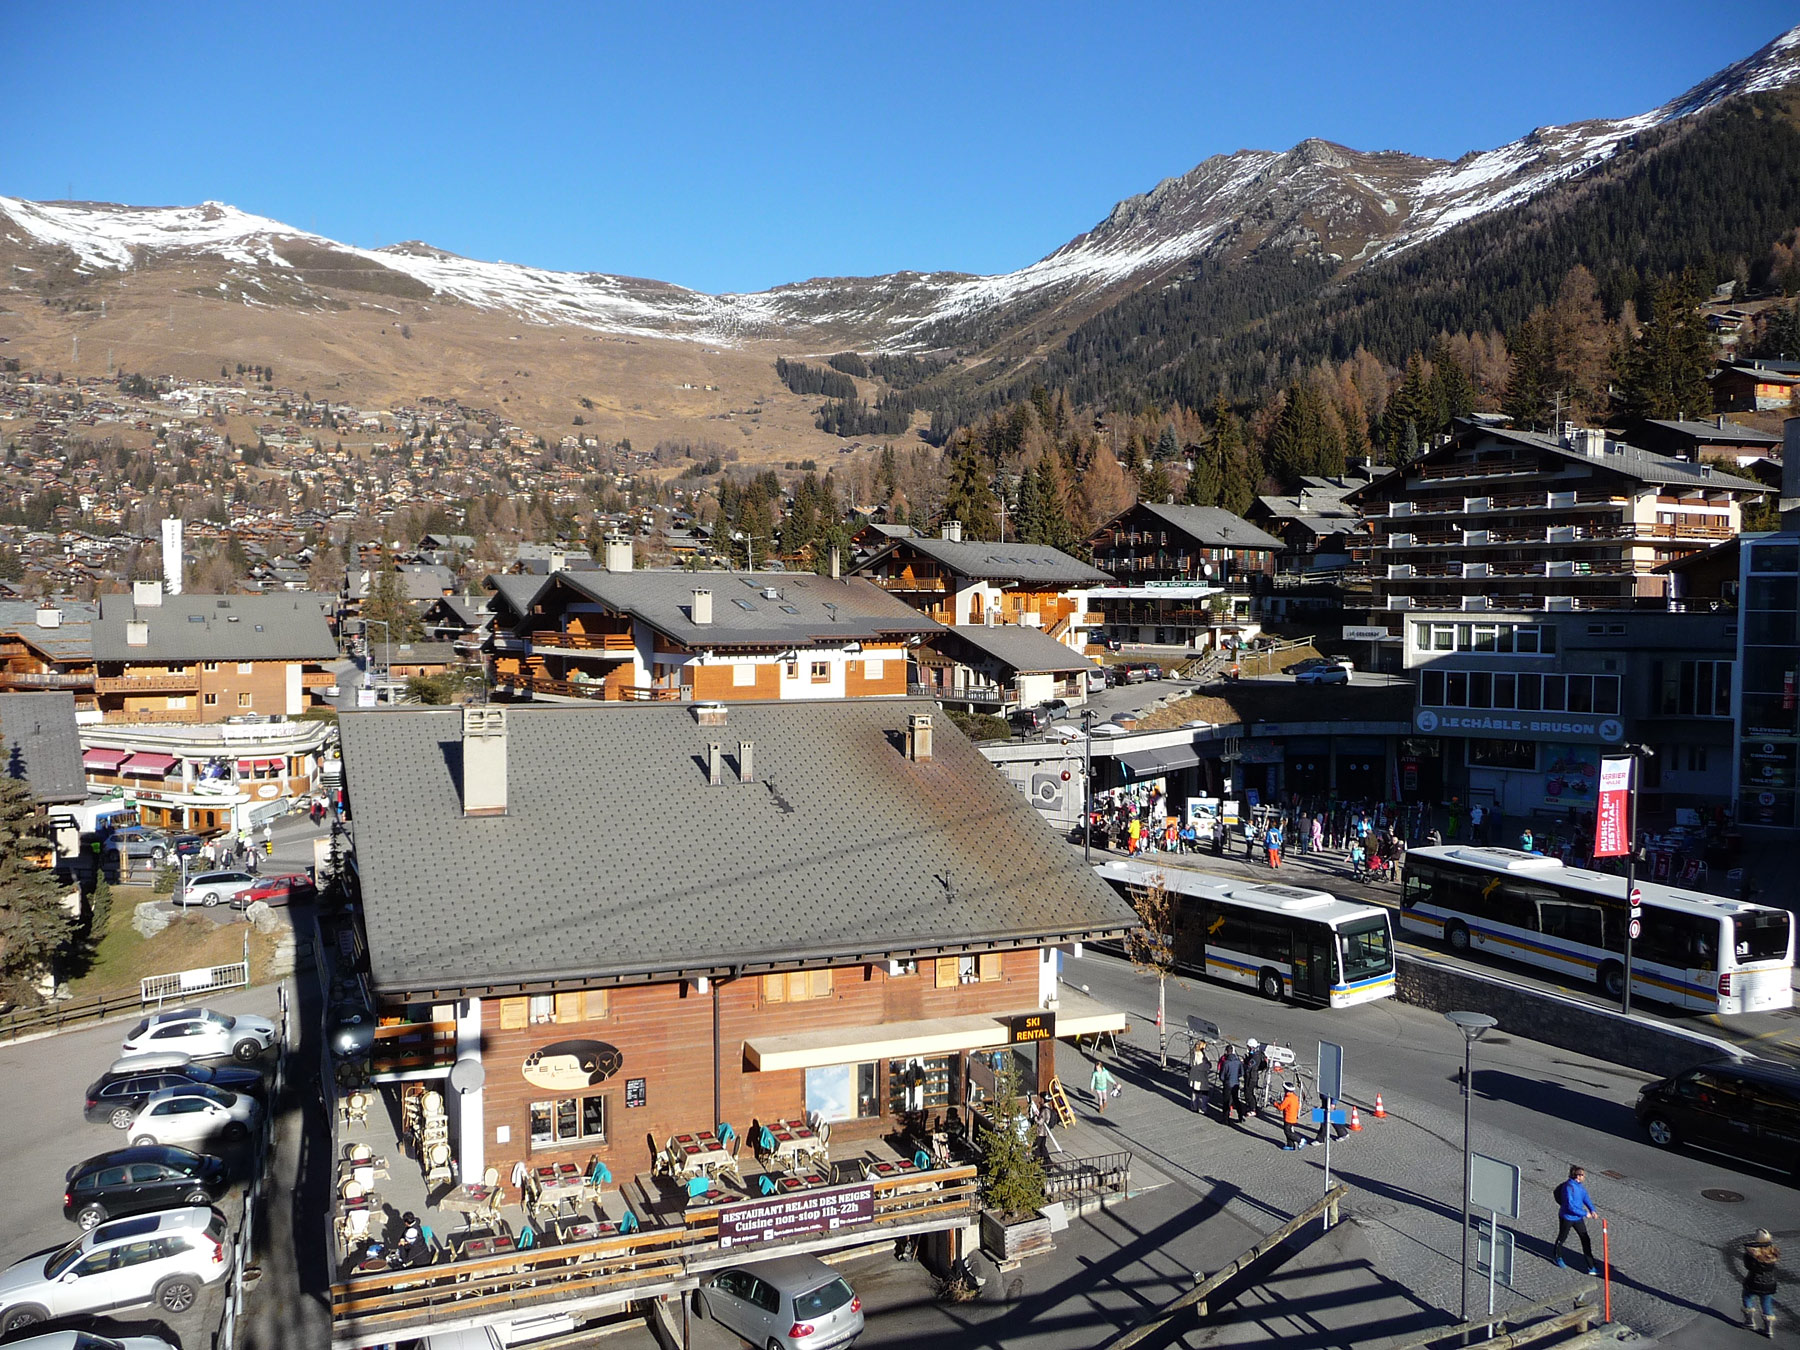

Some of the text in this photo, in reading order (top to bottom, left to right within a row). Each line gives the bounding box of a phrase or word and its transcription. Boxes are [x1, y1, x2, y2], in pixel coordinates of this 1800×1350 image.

[1441, 716, 1460, 728] LE
[1461, 716, 1521, 730] CHÂBLE
[1530, 721, 1595, 734] BRUSON
[1602, 772, 1626, 780] VERBIER
[1602, 793, 1610, 810] SKI
[1608, 802, 1616, 851] FESTIVAL
[1600, 820, 1608, 852] MUSIC
[1025, 1016, 1040, 1028] SKI
[1016, 1028, 1050, 1041] RENTAL
[524, 1058, 611, 1074] FELLAY
[722, 1190, 871, 1223] RESTAURANT RELAIS DES NEIGES
[735, 1202, 859, 1232] Cuisine non-stop 11h-22h
